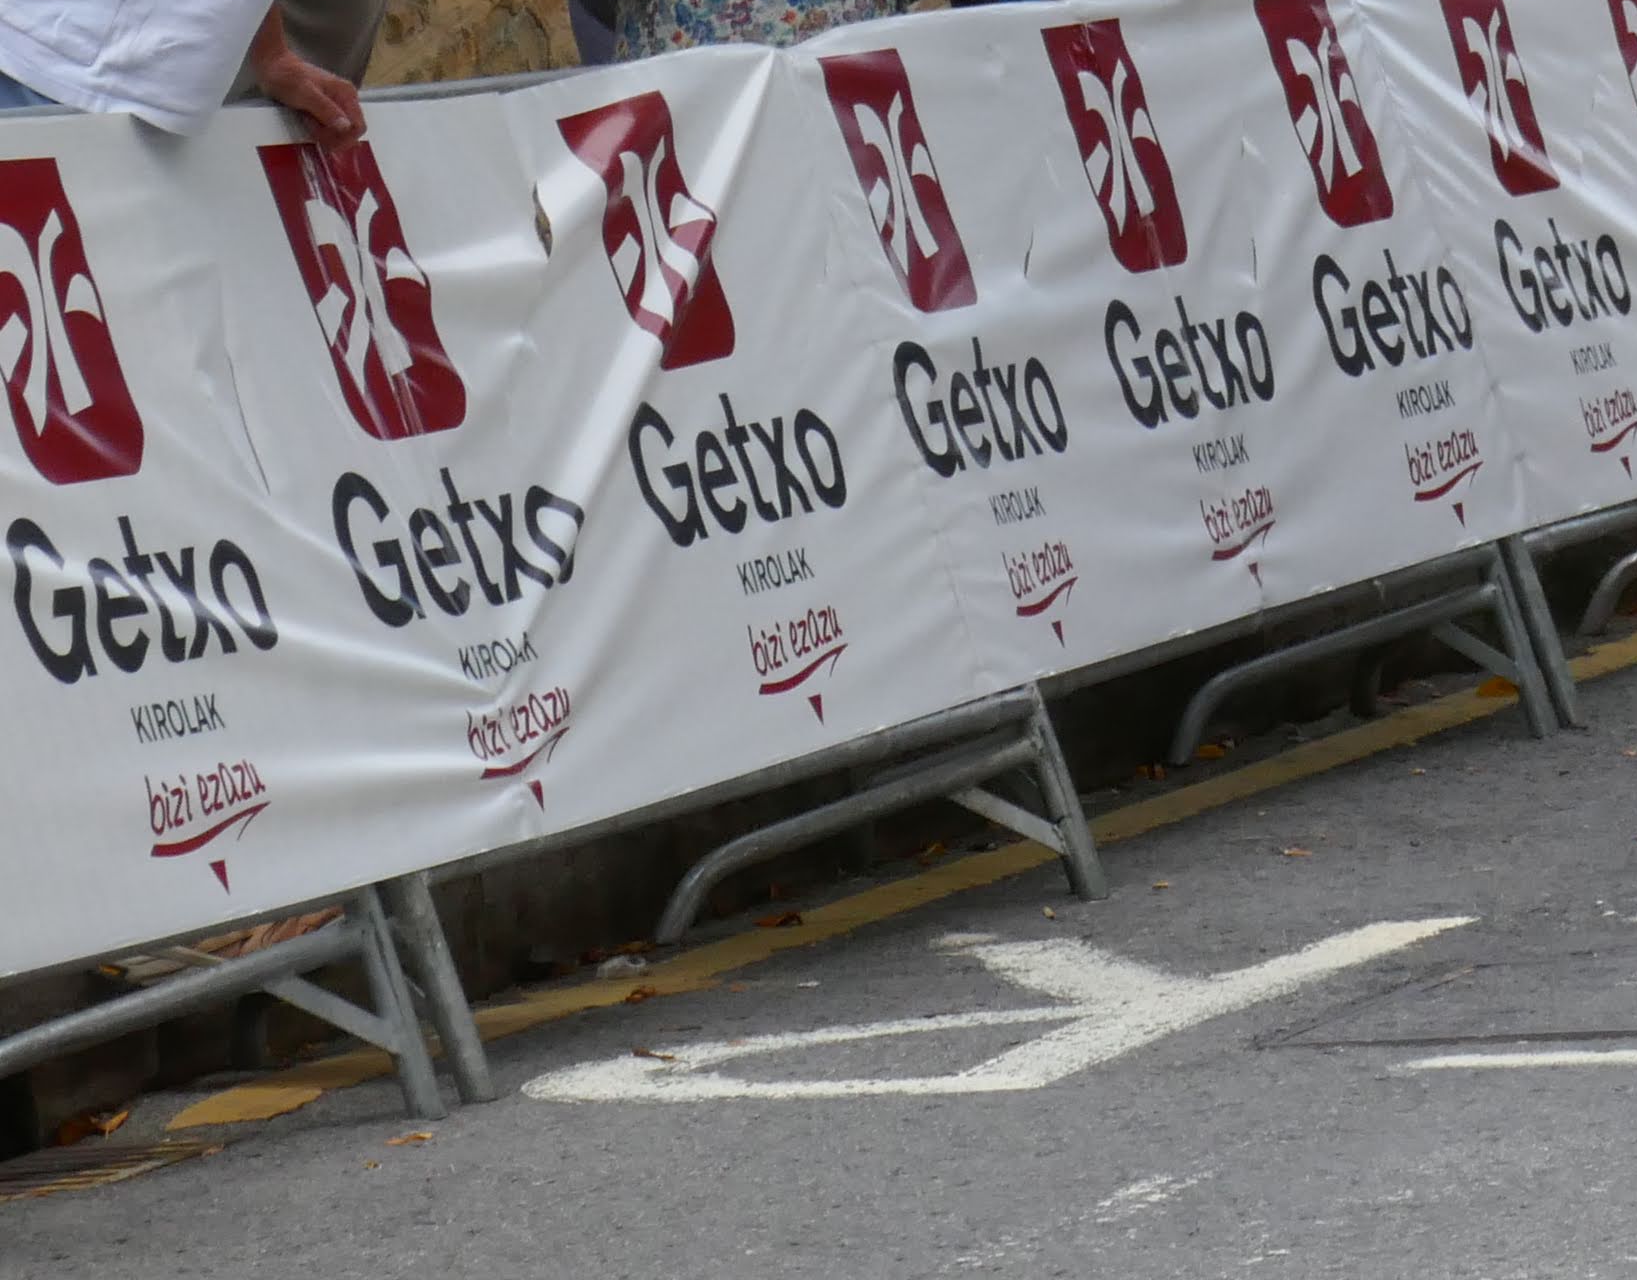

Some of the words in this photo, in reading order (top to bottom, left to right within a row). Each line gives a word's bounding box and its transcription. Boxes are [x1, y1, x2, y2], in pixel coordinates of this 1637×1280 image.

[1494, 217, 1631, 333] Getxo
[1312, 248, 1473, 377] Getxo
[1104, 295, 1275, 429] Getxo
[1569, 342, 1617, 376] KIROLAK
[893, 336, 1068, 478] Getxo
[1396, 380, 1456, 419] KIROLAK
[1578, 397, 1605, 438] bizi
[628, 392, 847, 548] Getxo
[1192, 433, 1250, 474] KIROLAK
[1405, 442, 1437, 486] bizi
[1436, 428, 1480, 472] ezazu
[988, 486, 1045, 527] KIROLAK
[1200, 498, 1231, 544] bizi
[1230, 484, 1275, 532] ezazu
[333, 468, 586, 628] Getxo
[736, 547, 815, 596] KIROLAK
[1002, 551, 1033, 600] bizi
[1032, 540, 1075, 585] ezazu
[6, 515, 279, 684] Getxo
[748, 623, 788, 677] bizi
[788, 605, 843, 656] ezazu
[130, 692, 226, 744] KIROLAK
[466, 706, 509, 761] bizi
[511, 686, 571, 745] ezazu
[144, 774, 194, 836] bizi
[199, 758, 267, 816] ezazu
